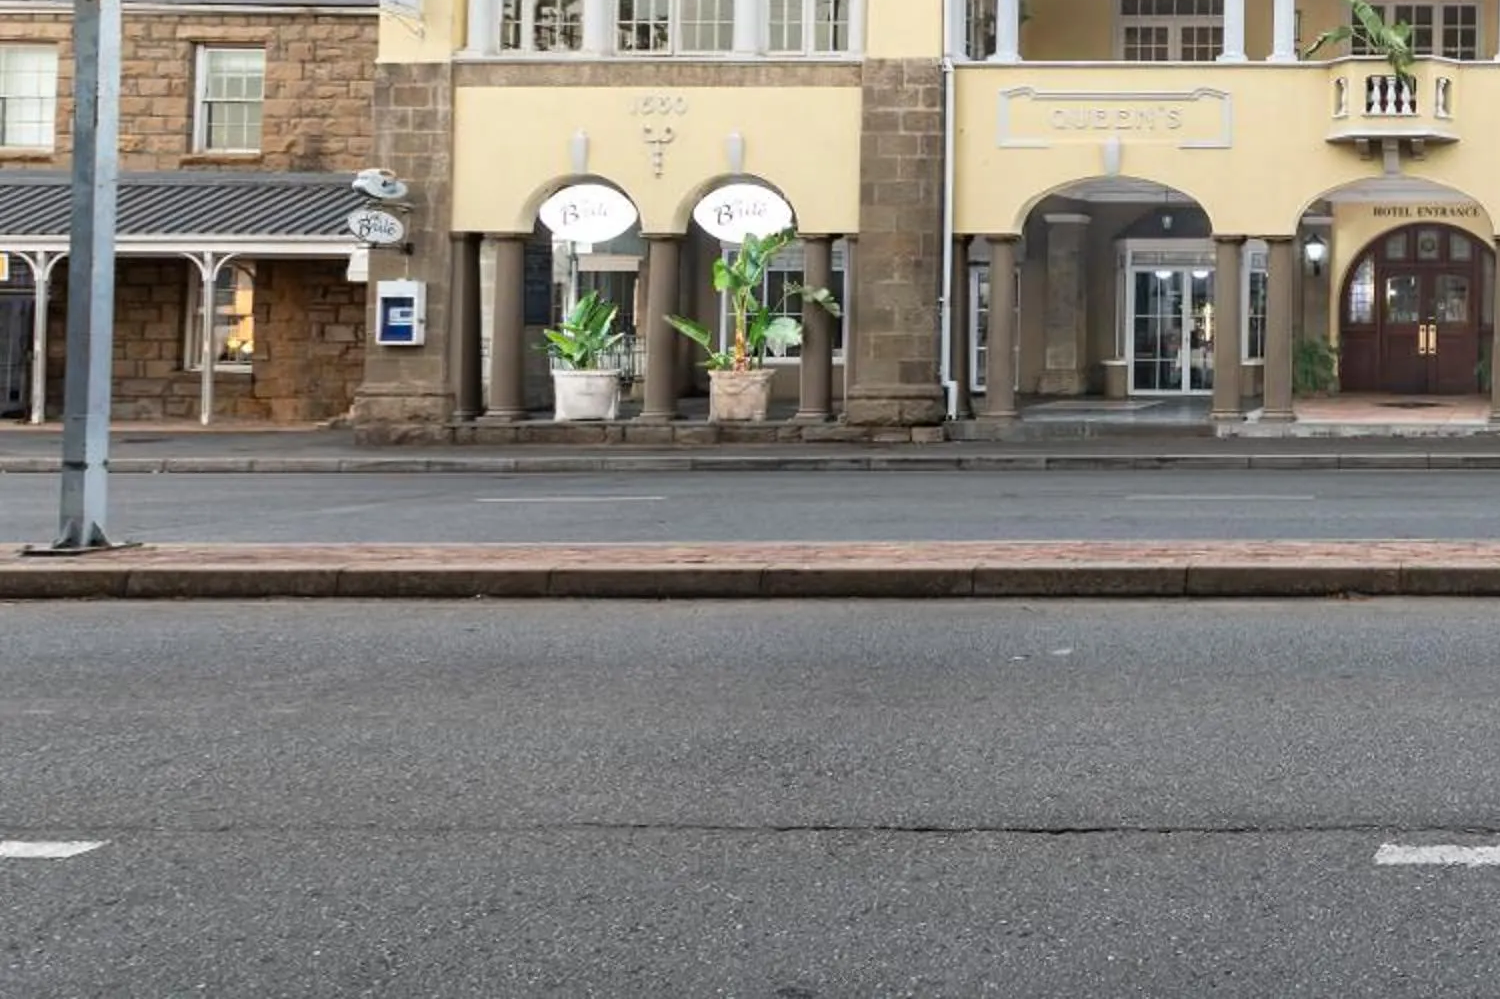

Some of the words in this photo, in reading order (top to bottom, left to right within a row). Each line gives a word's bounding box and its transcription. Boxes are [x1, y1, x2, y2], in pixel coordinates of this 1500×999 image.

[1049, 106, 1183, 130] QUEEN'S
[1373, 205, 1412, 218] HOTEL
[1417, 205, 1480, 218] ENTRANCE
